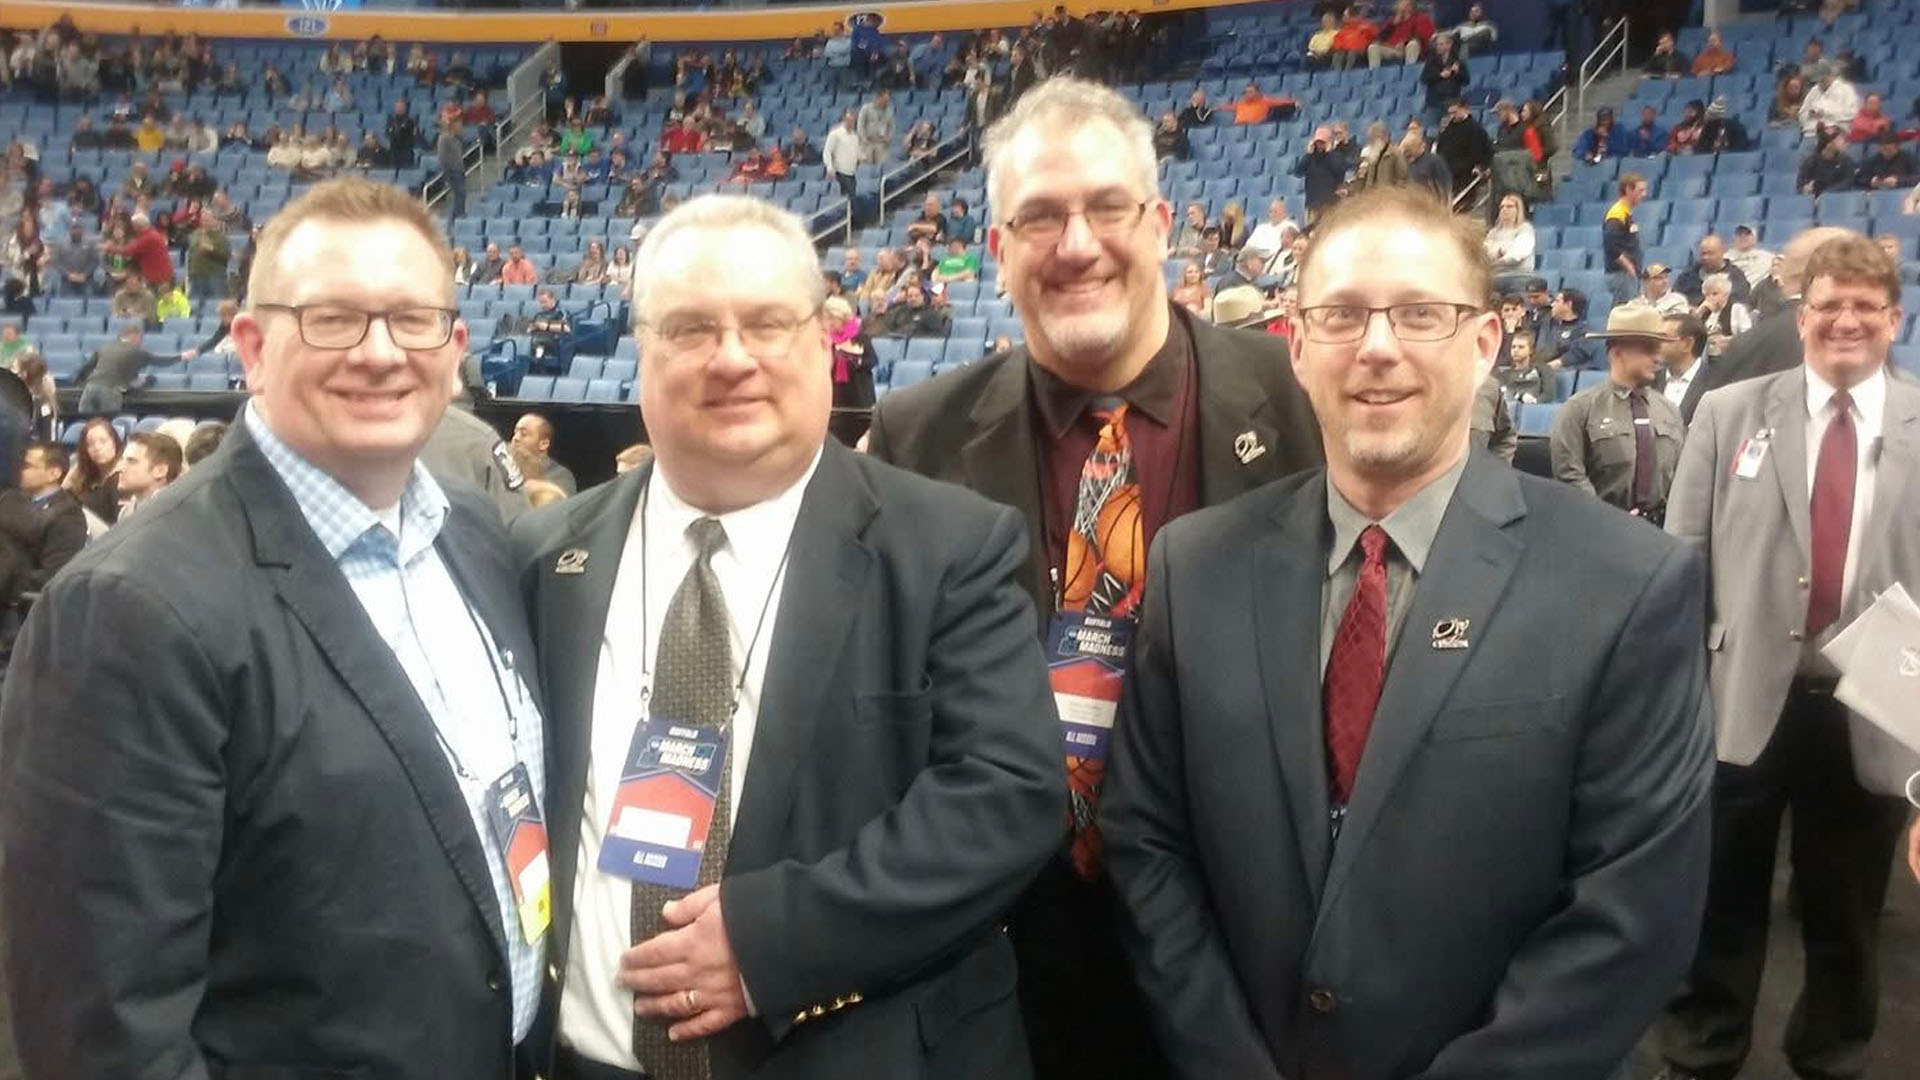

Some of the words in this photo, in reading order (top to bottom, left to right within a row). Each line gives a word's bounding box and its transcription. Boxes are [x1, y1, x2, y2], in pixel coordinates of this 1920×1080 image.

[1077, 629, 1112, 643] MARCH
[1079, 641, 1125, 655] MADNESS
[658, 739, 697, 757] MARCH
[659, 752, 710, 770] MADNESS
